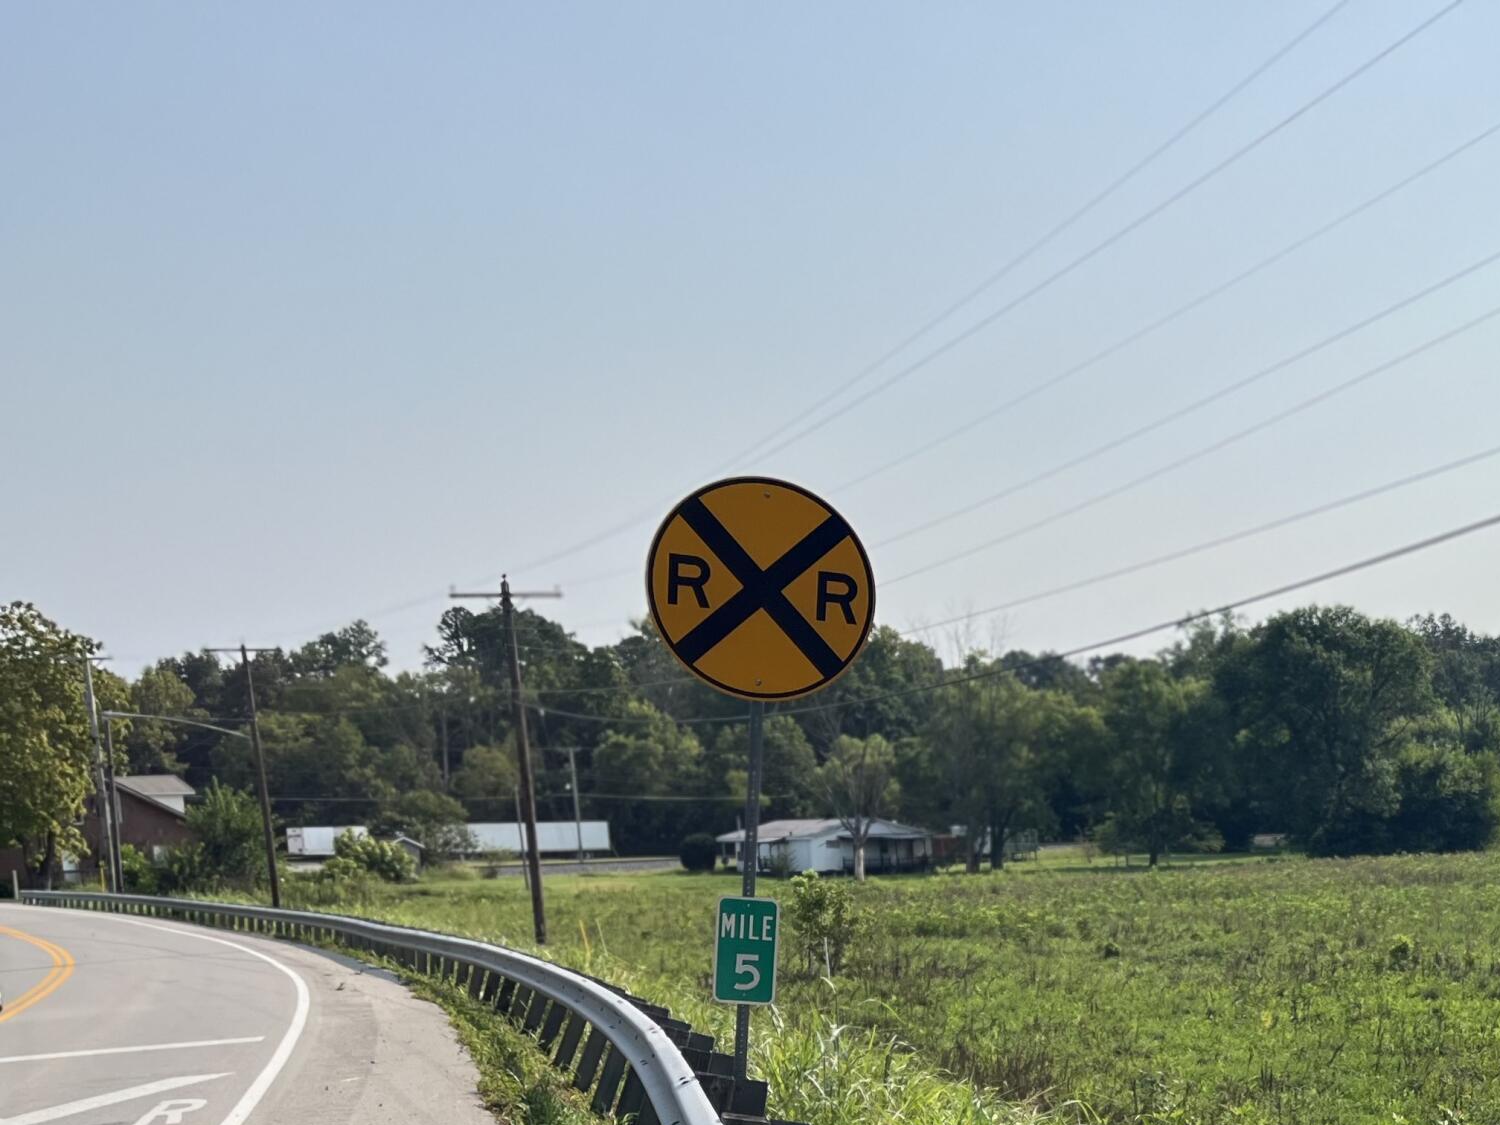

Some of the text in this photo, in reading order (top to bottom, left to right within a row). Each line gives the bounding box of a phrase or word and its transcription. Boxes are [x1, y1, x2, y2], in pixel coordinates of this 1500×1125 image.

[667, 552, 857, 625] R R
[721, 912, 774, 941] MILE
[734, 953, 760, 991] 5
